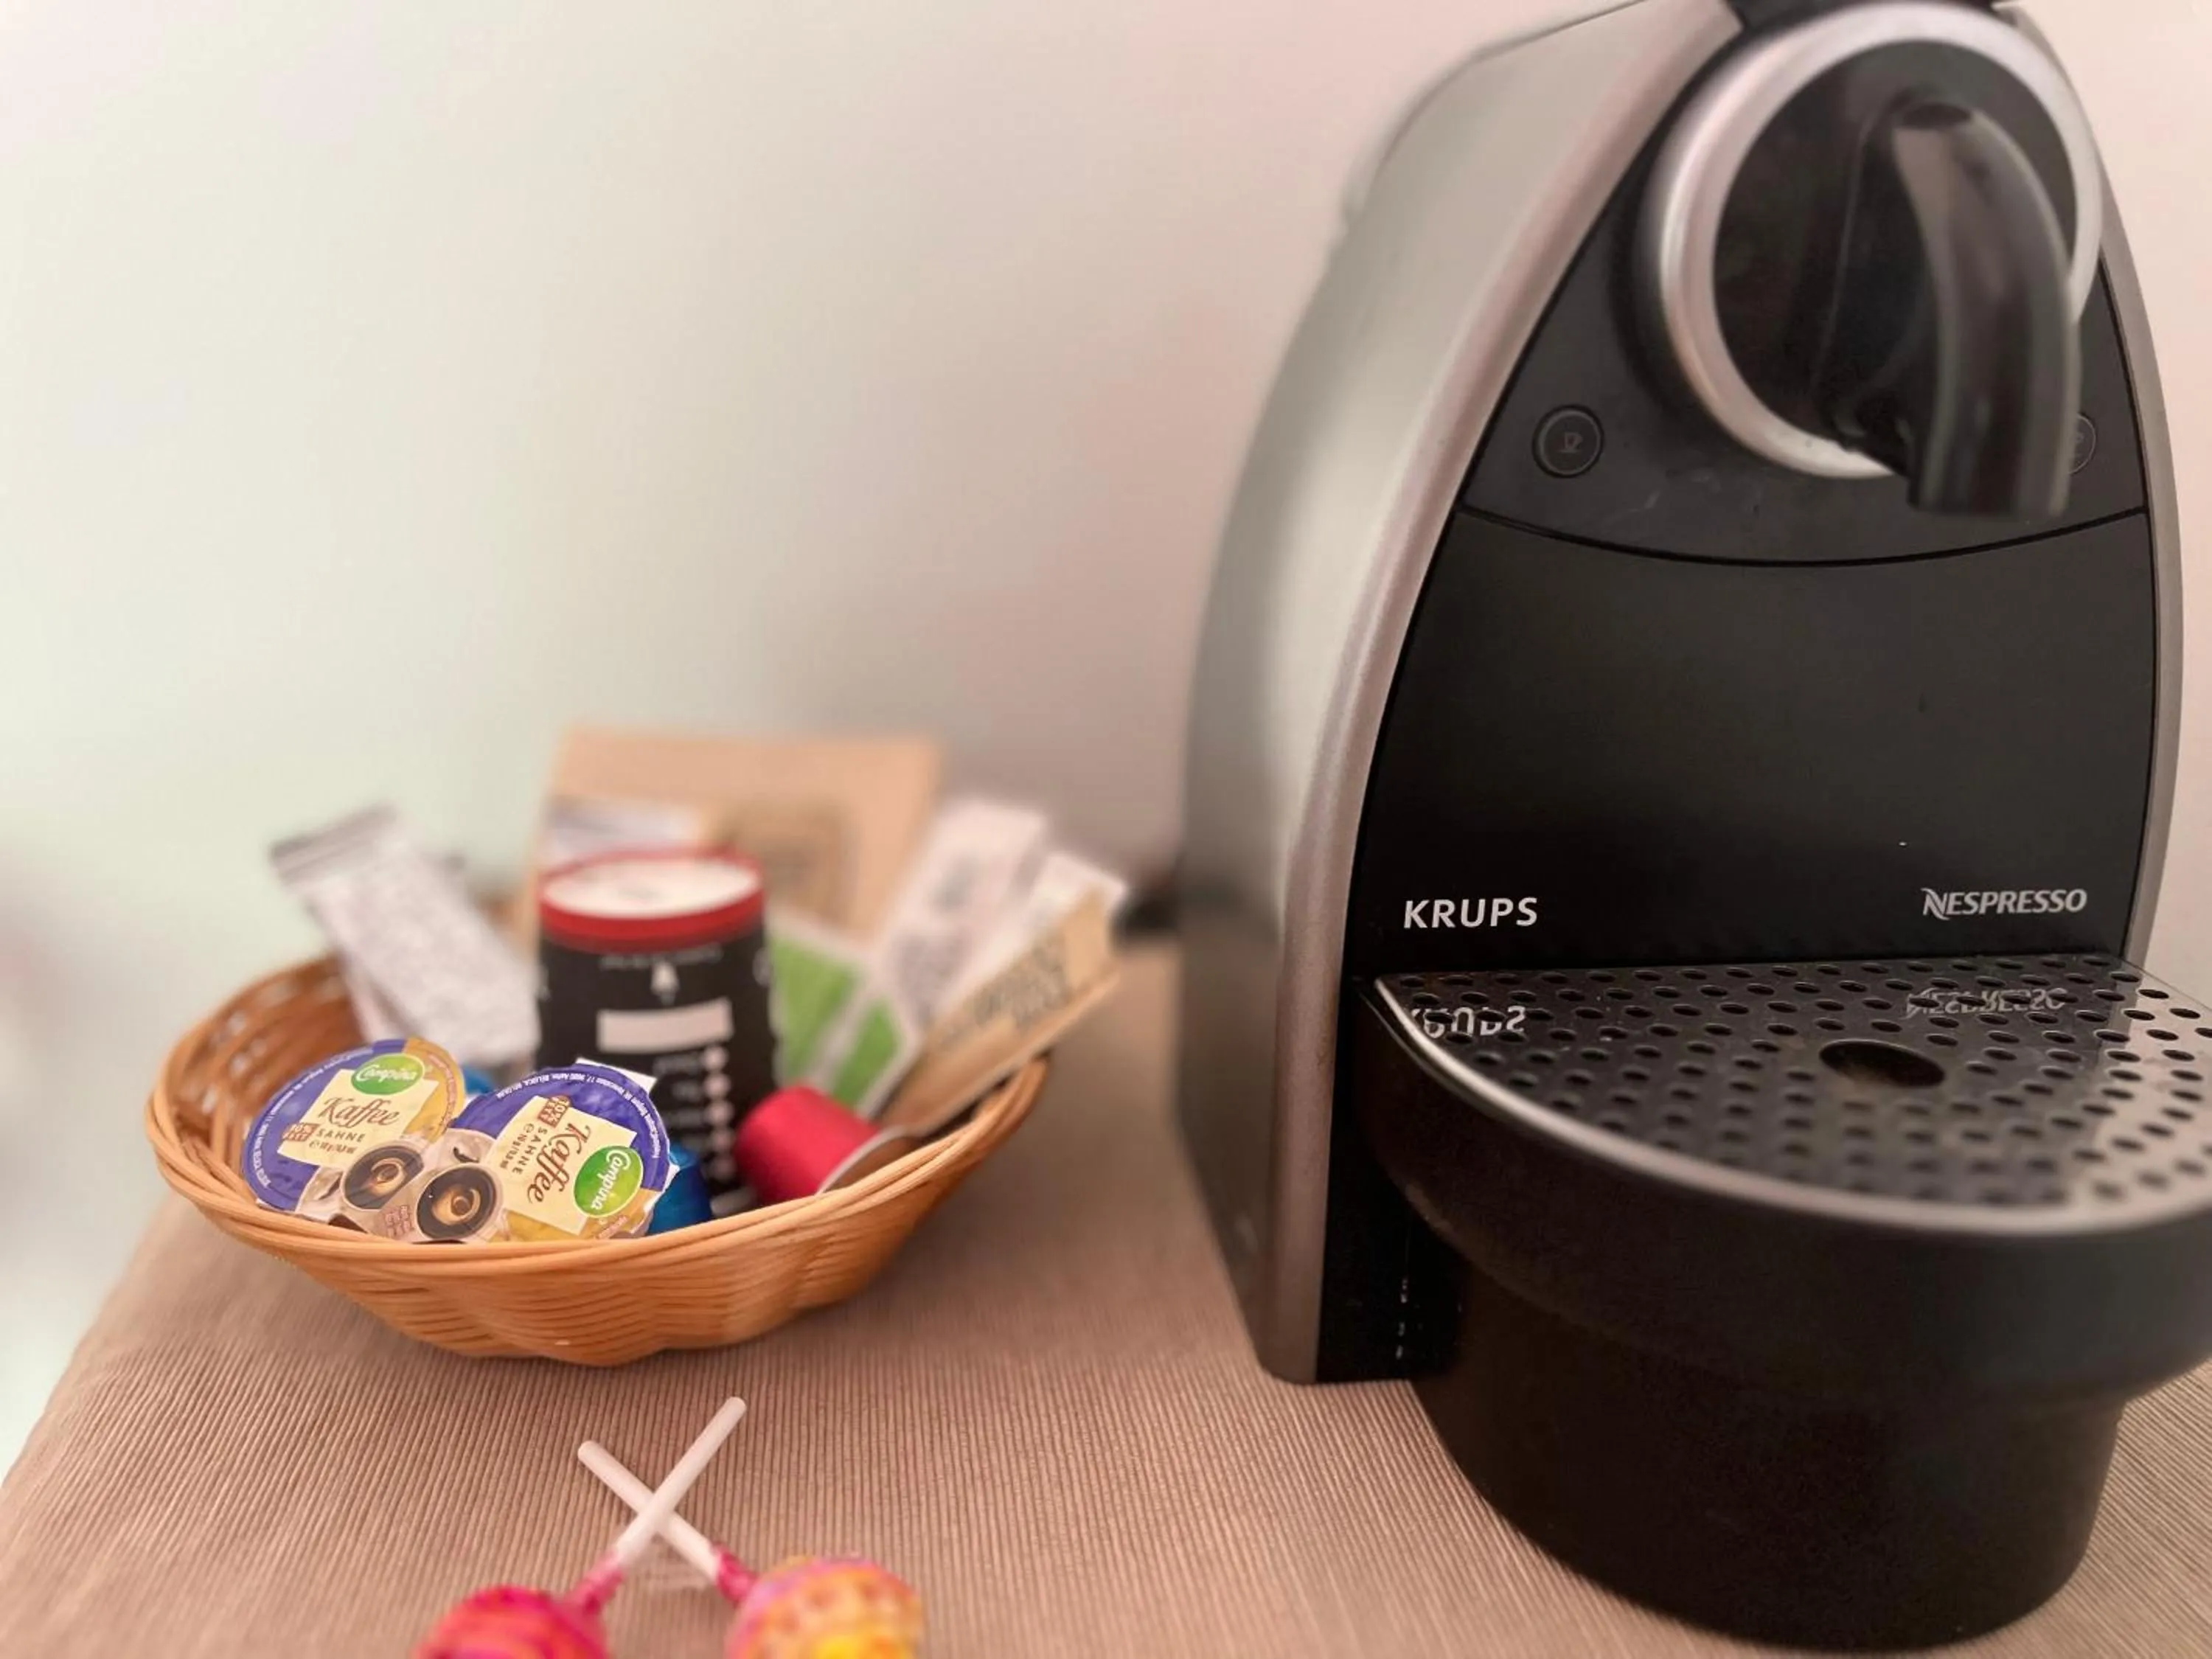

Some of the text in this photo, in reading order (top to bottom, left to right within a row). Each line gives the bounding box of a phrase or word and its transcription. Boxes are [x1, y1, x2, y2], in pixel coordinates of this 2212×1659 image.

[1403, 897, 1538, 929] KRUPS
[1920, 887, 2088, 921] NESPRESSO
[355, 1063, 417, 1083] Campina
[318, 1096, 400, 1130] Kaffee
[316, 1127, 366, 1143] SAHNE
[512, 1127, 549, 1175] SAHNE
[526, 1122, 591, 1204] Kaffee
[591, 1149, 632, 1211] Campina
